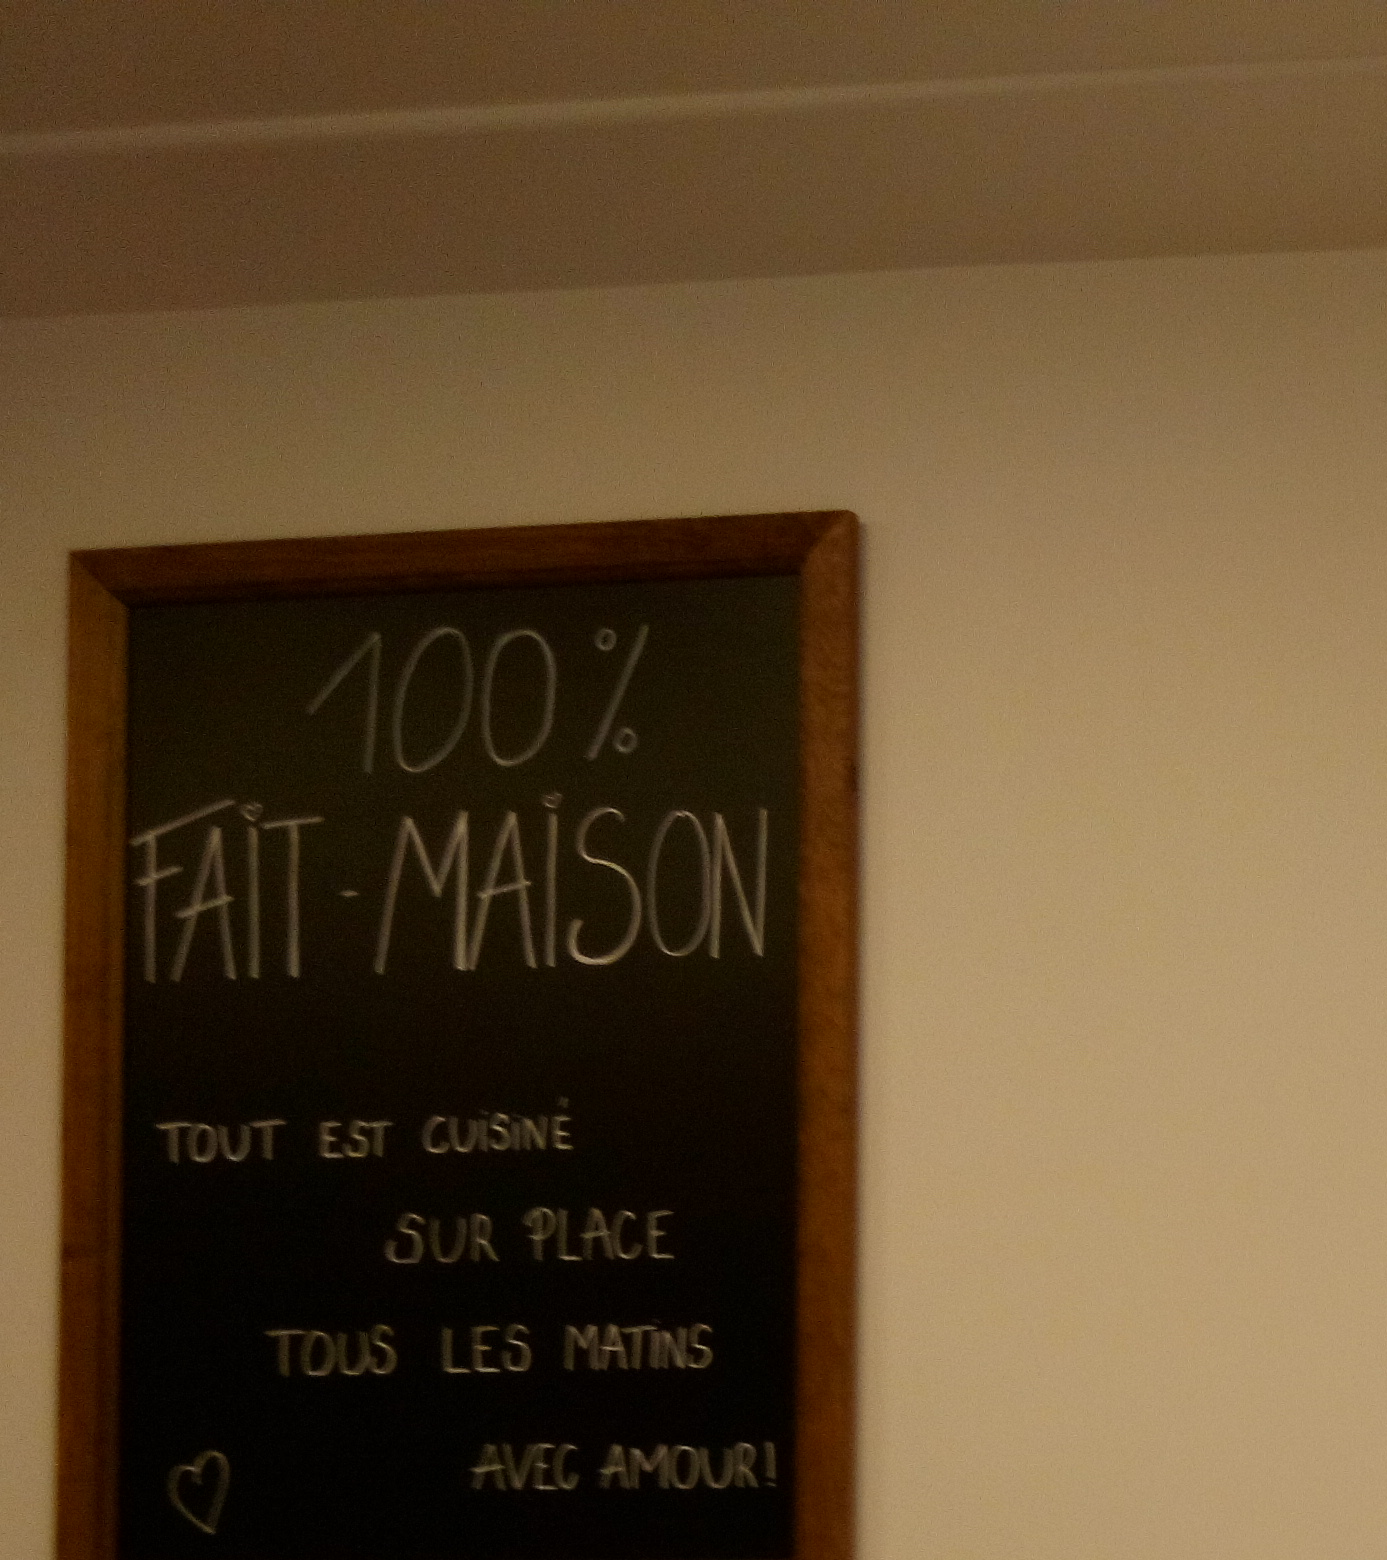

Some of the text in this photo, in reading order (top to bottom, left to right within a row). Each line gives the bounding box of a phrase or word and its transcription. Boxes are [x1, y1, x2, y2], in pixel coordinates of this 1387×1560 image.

[156, 1118, 288, 1164] TOUT
[319, 1119, 395, 1159] EST
[383, 1207, 677, 1265] SUR PLACE
[265, 1318, 714, 1378] TOUS LES MATINS
[470, 1442, 580, 1490] AVEC
